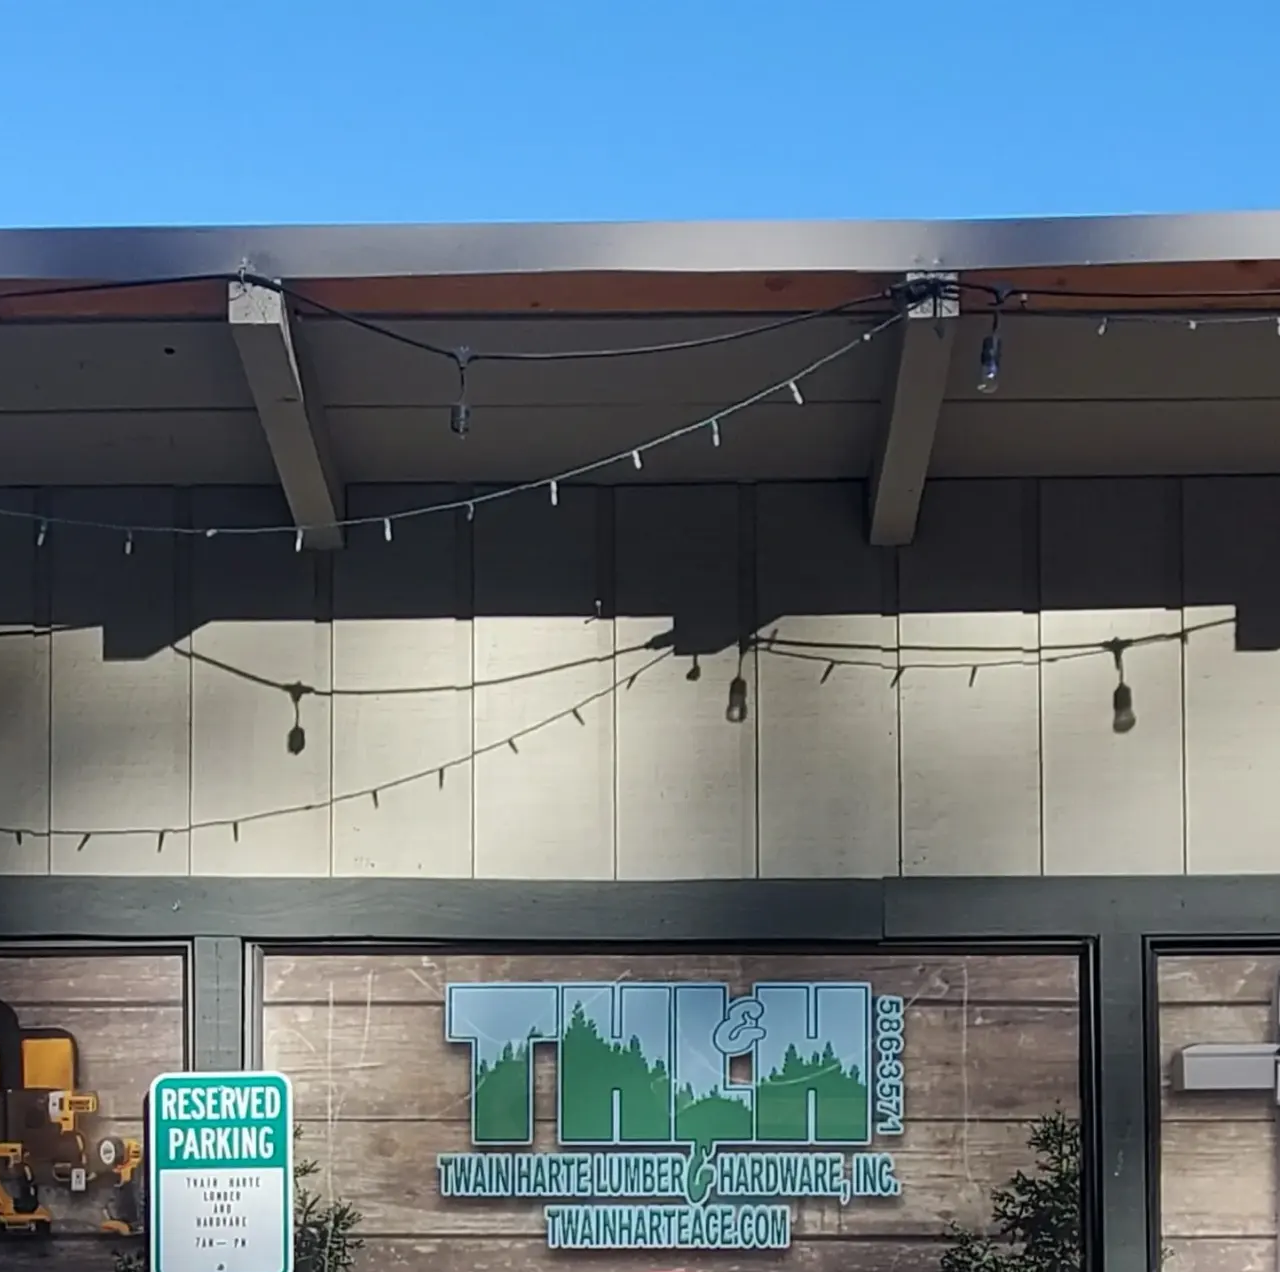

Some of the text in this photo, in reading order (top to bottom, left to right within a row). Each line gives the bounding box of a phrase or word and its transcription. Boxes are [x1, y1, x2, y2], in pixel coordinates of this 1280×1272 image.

[879, 998, 903, 1133] 586-3571
[161, 1085, 281, 1121] RESERVED
[168, 1126, 274, 1161] PARKING
[439, 1156, 511, 1194] TWAIN
[517, 1156, 592, 1194] HARTE
[596, 1156, 684, 1193] LUMBER
[719, 1155, 851, 1202] HARDWARE,
[855, 1155, 900, 1194] INC.
[547, 1207, 788, 1247] TWAINHARTEACE.COM
